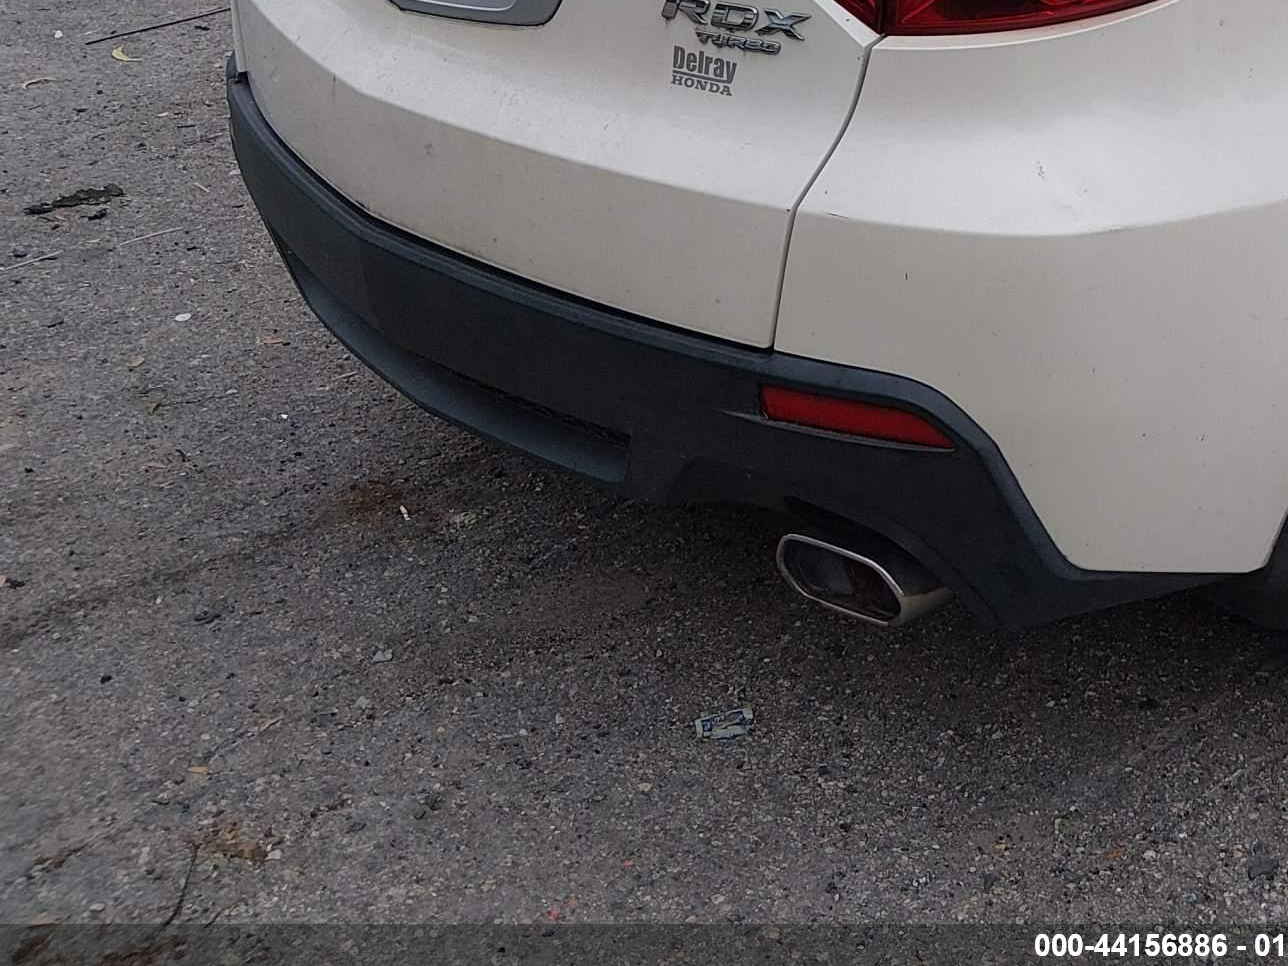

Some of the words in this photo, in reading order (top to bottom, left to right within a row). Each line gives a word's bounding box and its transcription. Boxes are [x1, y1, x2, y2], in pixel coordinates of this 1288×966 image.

[695, 29, 782, 56] TURBO
[673, 45, 737, 84] Delray
[670, 74, 733, 97] HONDA
